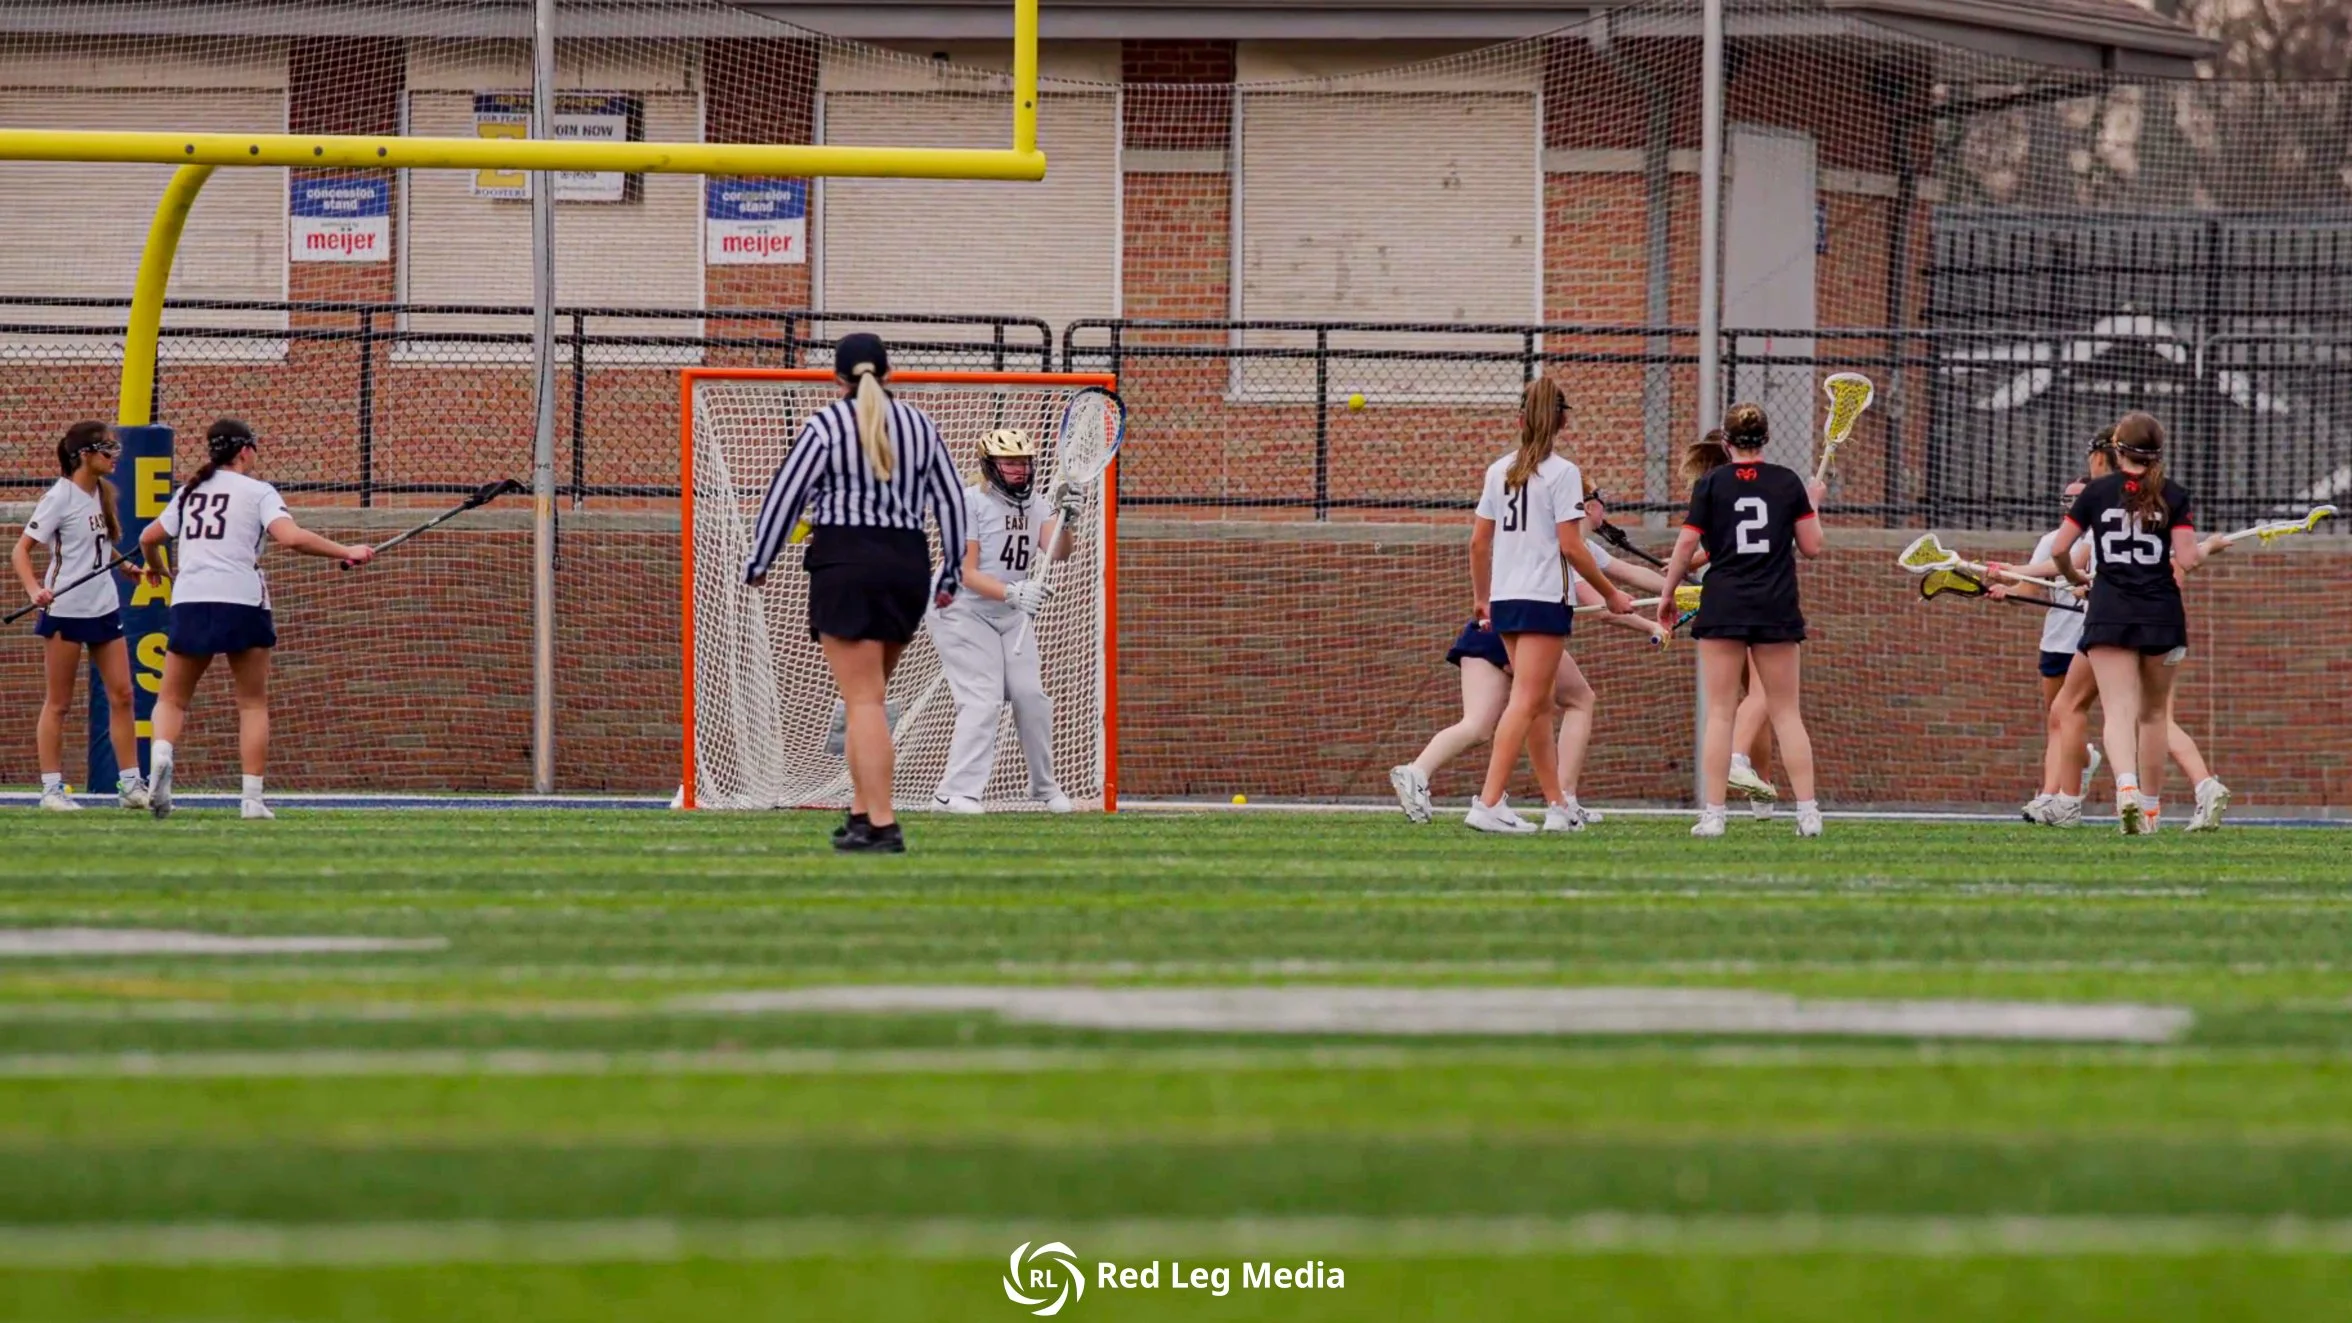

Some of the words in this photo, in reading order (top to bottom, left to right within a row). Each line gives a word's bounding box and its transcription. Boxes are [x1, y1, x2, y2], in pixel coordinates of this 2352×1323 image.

[553, 125, 578, 137] OIN
[582, 125, 613, 137] NOW
[306, 187, 375, 200] concession
[323, 199, 358, 211] stand
[738, 201, 775, 213] stand
[306, 226, 376, 256] meijer
[723, 229, 792, 257] meijer
[186, 493, 230, 540] 33
[1503, 478, 1528, 532] 31
[1005, 515, 1029, 531] EAST
[1734, 496, 1770, 554] 2
[2100, 507, 2163, 565] 25
[1000, 534, 1030, 571] 46
